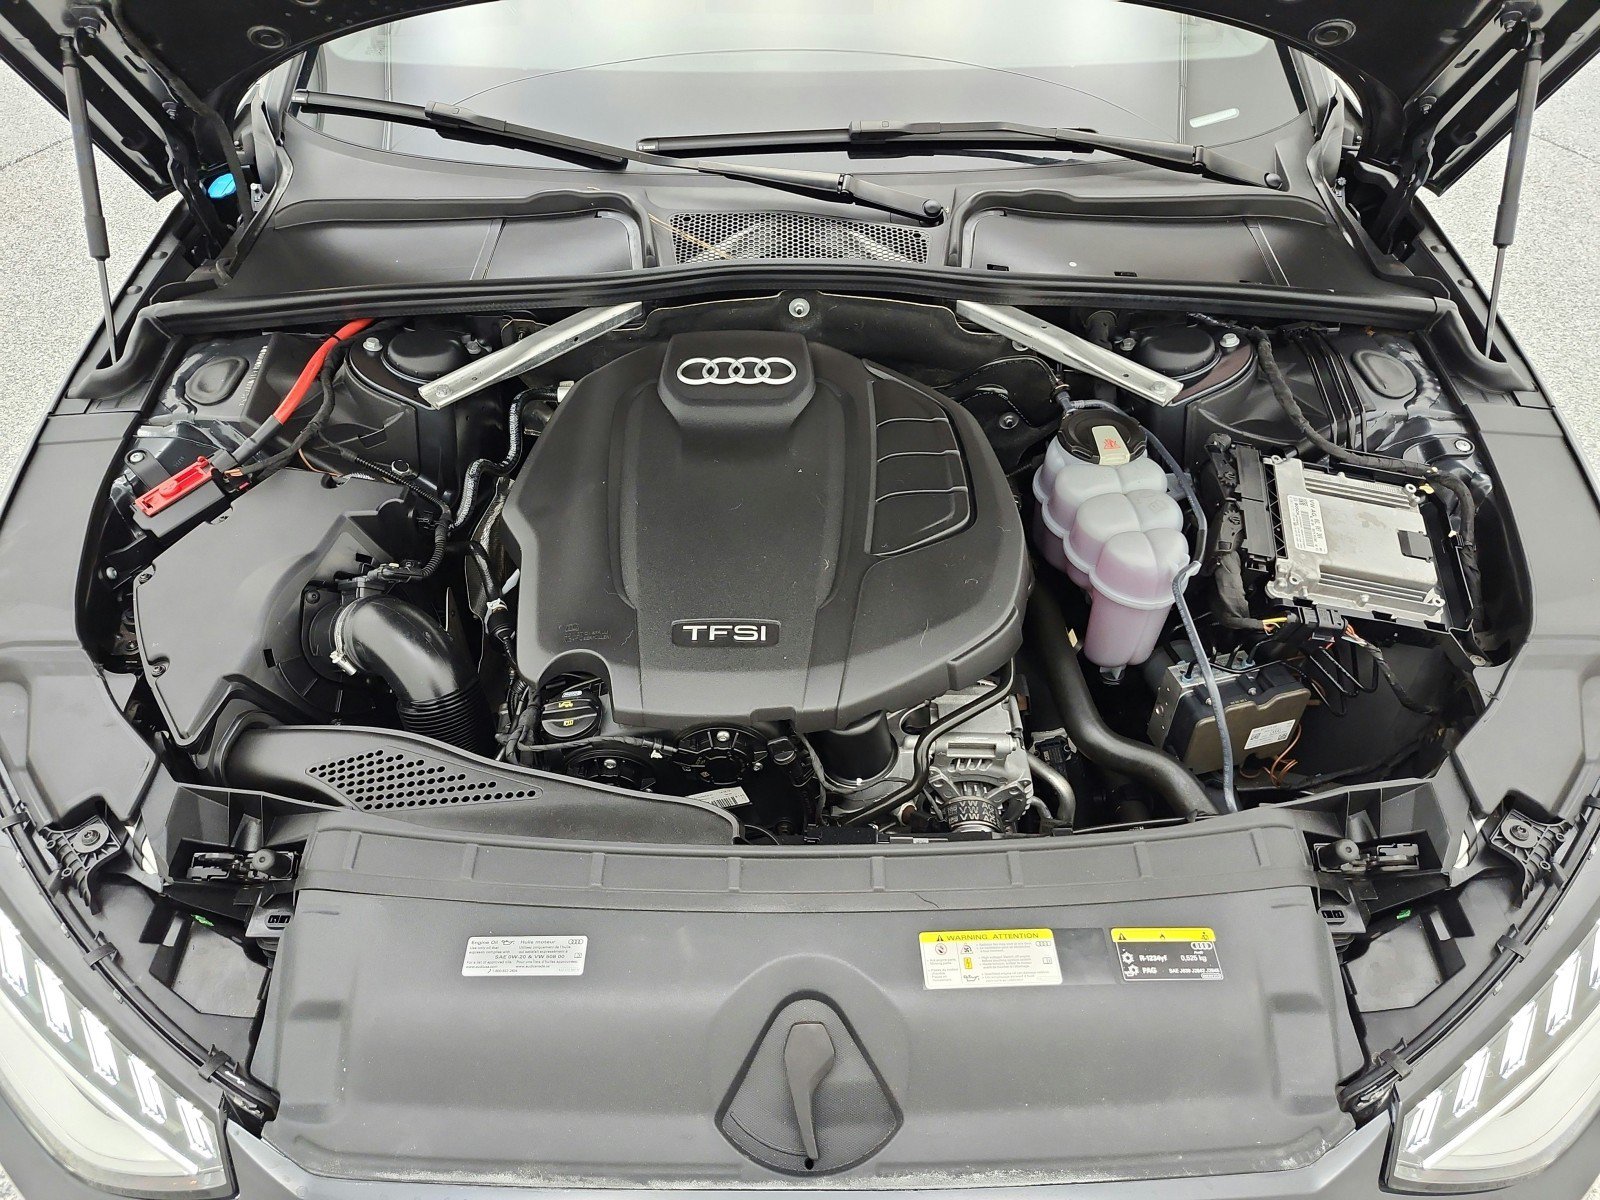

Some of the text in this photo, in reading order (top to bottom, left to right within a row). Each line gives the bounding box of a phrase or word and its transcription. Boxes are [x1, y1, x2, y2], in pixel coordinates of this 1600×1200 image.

[682, 625, 767, 641] TFSI
[959, 806, 979, 814] VW
[959, 813, 980, 821] VW
[992, 932, 1040, 940] ATTENTION
[1138, 955, 1168, 963] R-1234yf
[1198, 955, 1208, 963] kg
